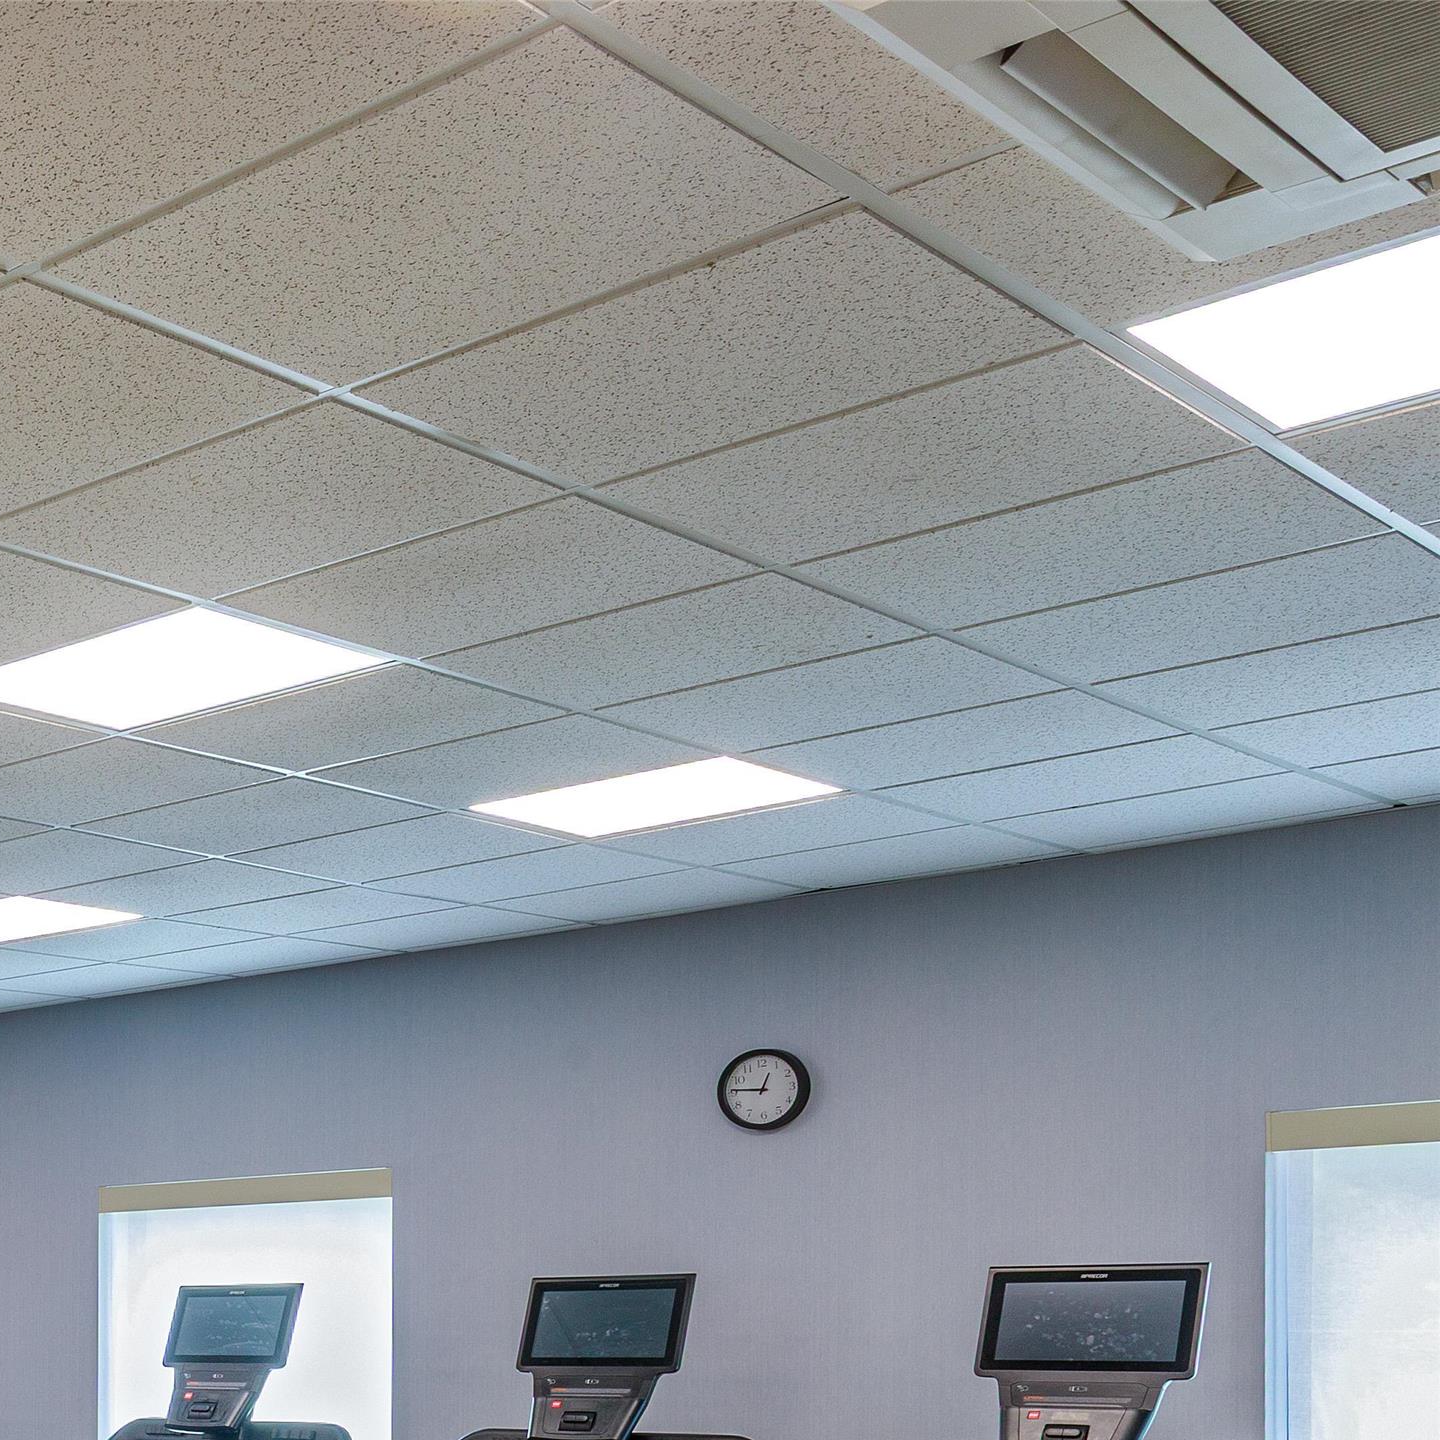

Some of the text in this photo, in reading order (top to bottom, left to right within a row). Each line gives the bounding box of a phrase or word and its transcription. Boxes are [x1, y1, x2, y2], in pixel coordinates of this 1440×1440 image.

[743, 1063, 752, 1073] 11
[757, 1059, 767, 1068] 12
[775, 1061, 778, 1069] 1
[784, 1069, 791, 1078] 2
[734, 1076, 745, 1085] 10
[789, 1081, 796, 1091] 3
[785, 1096, 791, 1104] 4
[734, 1101, 742, 1110] 8
[746, 1109, 752, 1120] 7
[776, 1106, 782, 1115] 5
[760, 1111, 768, 1120] 6
